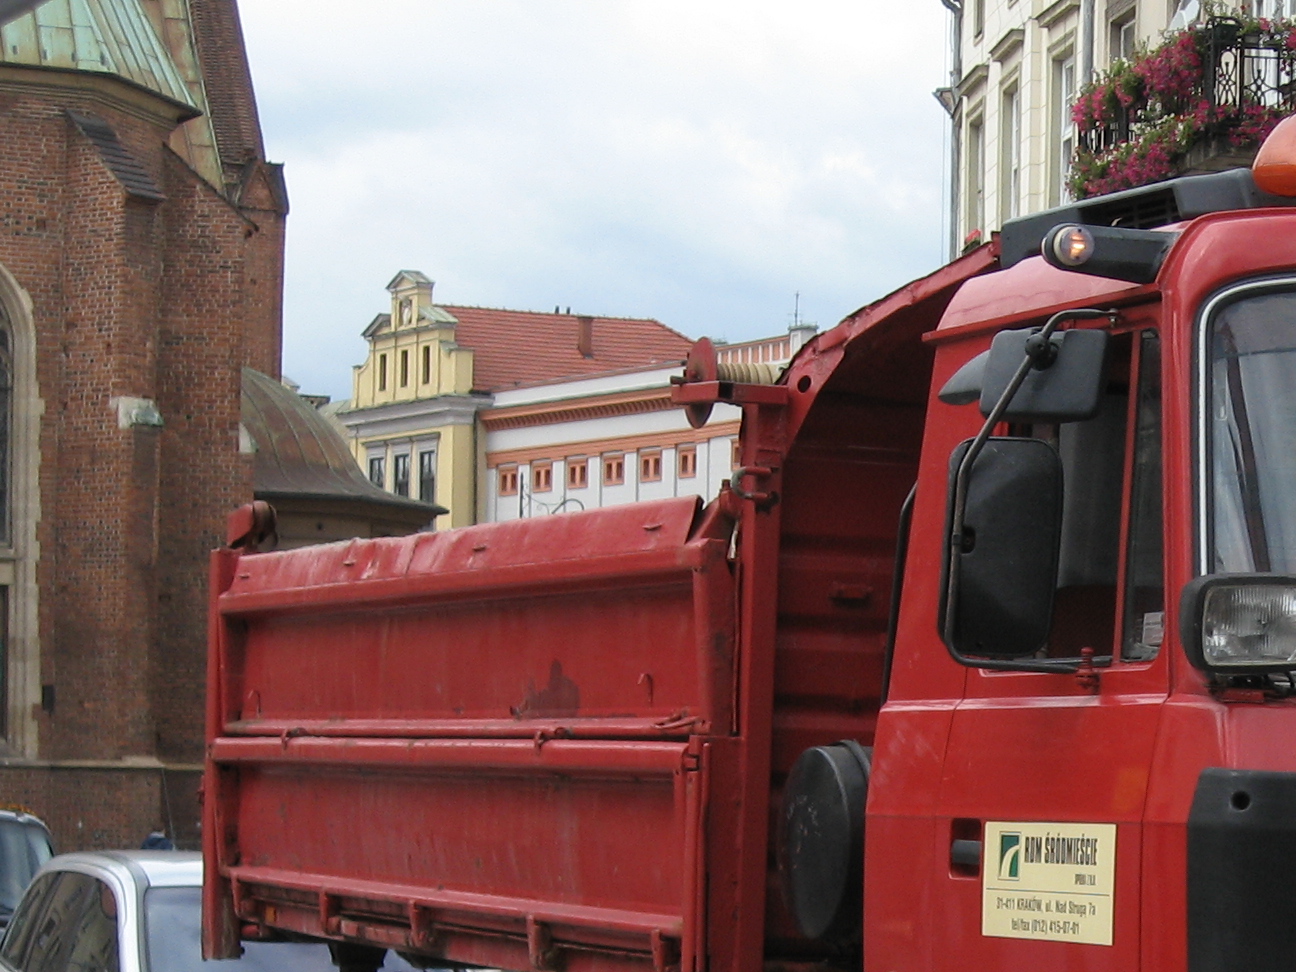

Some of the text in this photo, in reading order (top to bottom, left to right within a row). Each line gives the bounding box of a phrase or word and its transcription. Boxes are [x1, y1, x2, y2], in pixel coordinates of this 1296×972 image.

[1024, 832, 1098, 866] RDM ŚRÓDMIEŚCIE
[1017, 896, 1044, 913] KRAKÓW,
[1055, 900, 1067, 914] Nad
